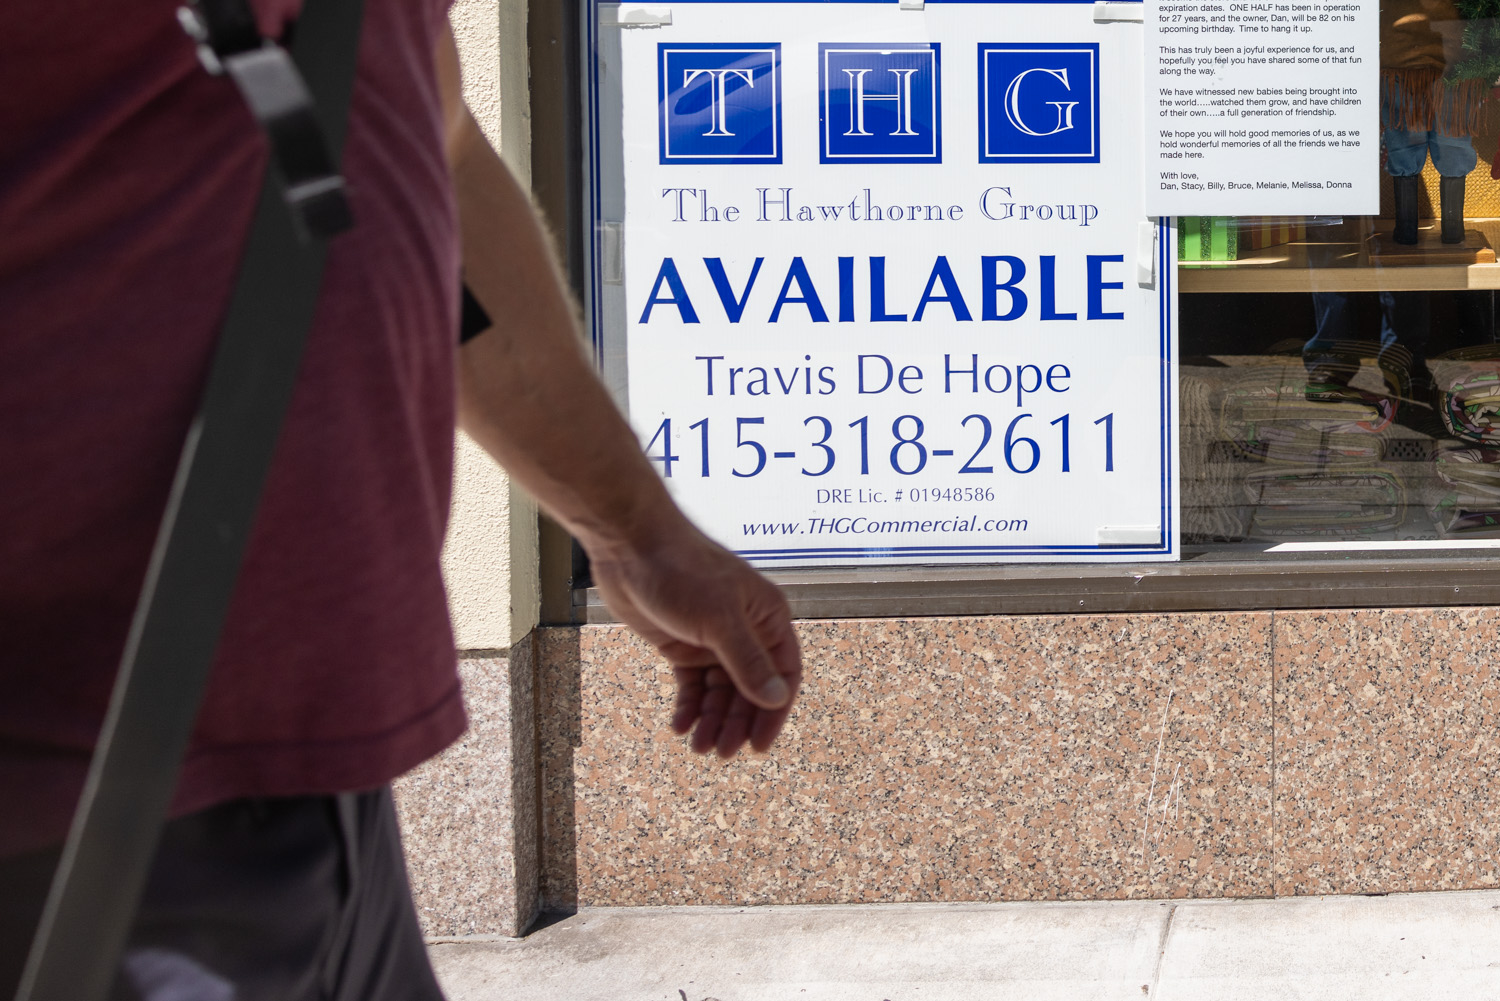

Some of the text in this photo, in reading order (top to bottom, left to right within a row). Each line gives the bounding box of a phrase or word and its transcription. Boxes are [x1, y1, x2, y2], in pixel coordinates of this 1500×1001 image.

[1159, 4, 1198, 13] expiration
[1251, 4, 1273, 13] HALF
[1276, 4, 1289, 13] has
[1323, 3, 1360, 13] operation
[1159, 15, 1170, 24] for
[1271, 14, 1289, 22] Dan,
[1159, 24, 1198, 34] upcoming
[1202, 25, 1235, 34] birthday.
[1271, 25, 1291, 34] hang
[1301, 24, 1312, 34] up.
[1195, 46, 1212, 55] truly
[1243, 46, 1264, 55] joyful
[1267, 46, 1310, 55] experience
[1340, 46, 1354, 54] and
[1160, 57, 1195, 66] hopefully
[1198, 55, 1212, 66] you
[1215, 55, 1228, 64] feel
[1248, 55, 1266, 64] have
[1160, 67, 1181, 76] along
[1199, 66, 1215, 76] way.
[1285, 88, 1307, 96] being
[1310, 87, 1340, 96] brought
[1175, 130, 1195, 139] hope
[1249, 129, 1269, 139] good
[1180, 139, 1219, 148] wonderful
[1222, 139, 1260, 147] memories
[1181, 172, 1199, 181] love,
[1160, 182, 1178, 190] Dan,
[1181, 182, 1205, 191] Stacy,
[1208, 182, 1225, 191] Billy,
[1228, 182, 1254, 190] Bruce,
[663, 187, 1098, 226] The Hawthorne Group
[639, 255, 1124, 323] AVAILABLE
[696, 354, 1070, 407] Travis De Hope
[643, 411, 1115, 478] 415-318-2611
[818, 488, 994, 503] DRE Lic. # 01948586
[744, 515, 1027, 535] www.THGCommercial.com
